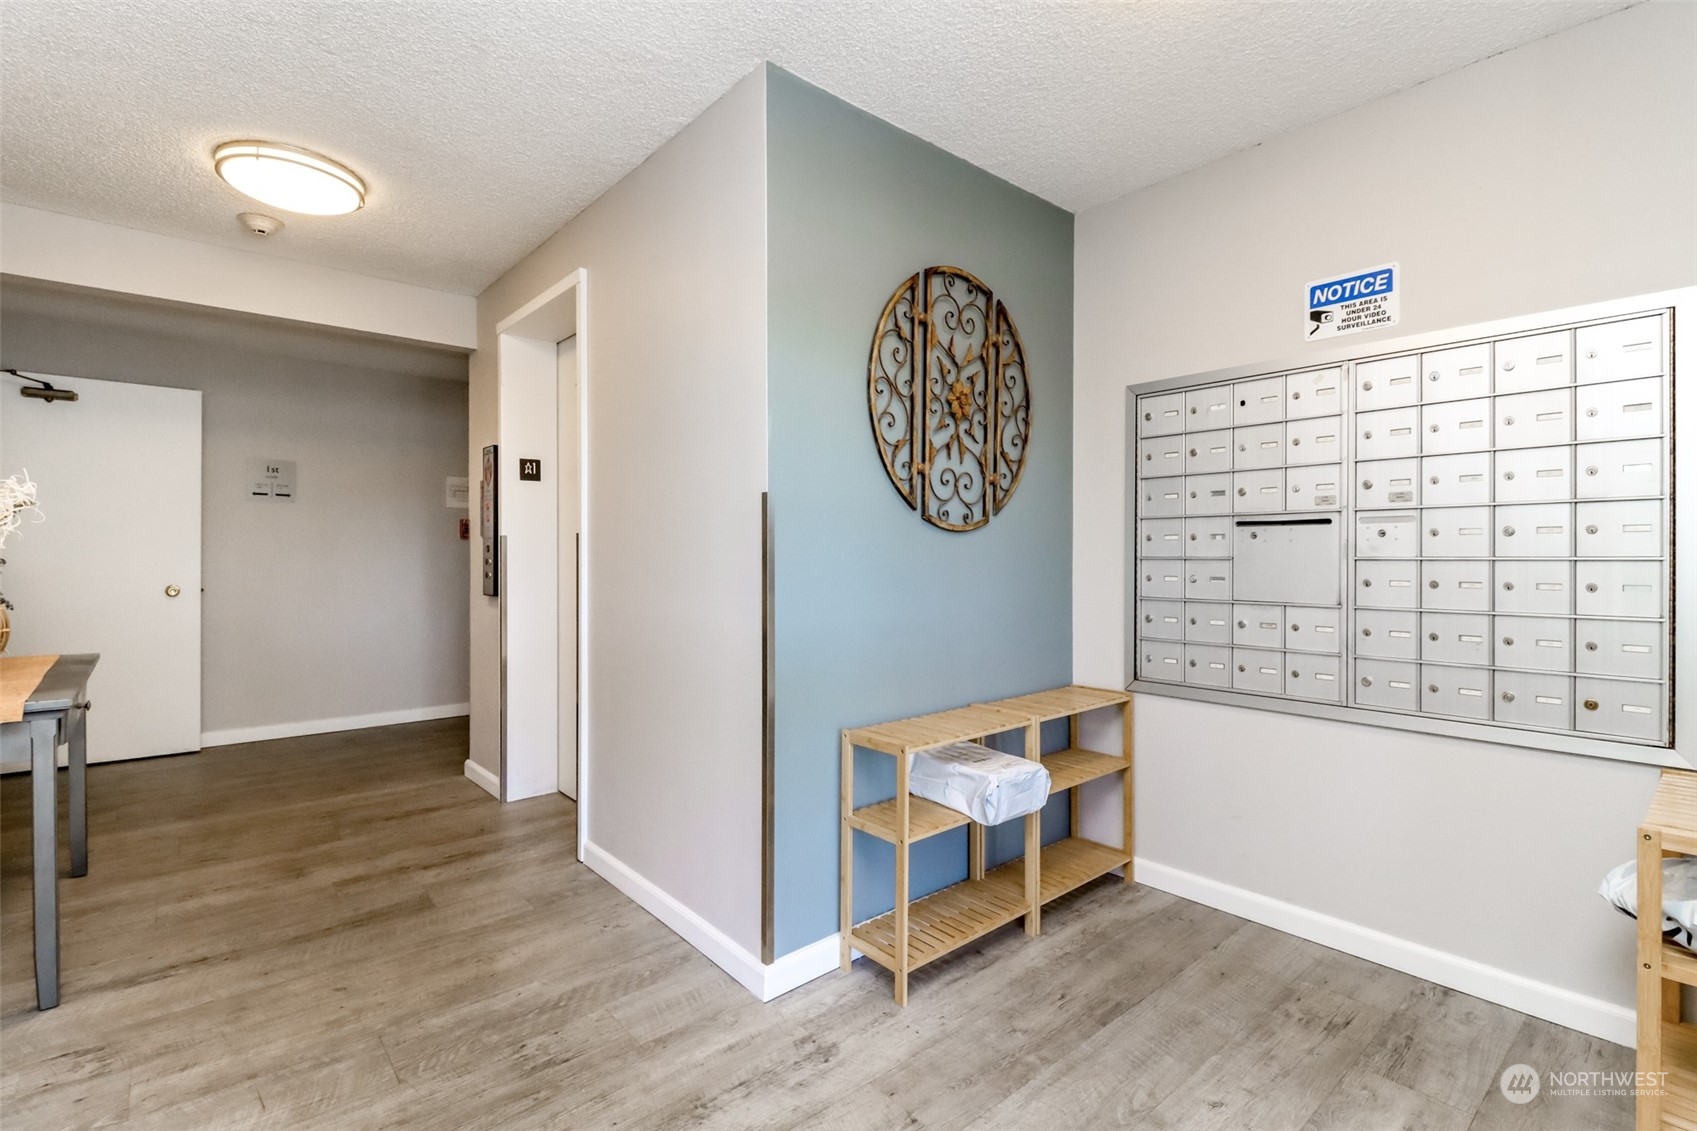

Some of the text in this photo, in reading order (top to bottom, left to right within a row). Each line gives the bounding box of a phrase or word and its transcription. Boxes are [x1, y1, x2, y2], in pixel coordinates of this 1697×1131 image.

[1313, 273, 1389, 304] NOTICE
[1340, 302, 1357, 310] THIS
[1359, 298, 1378, 306] AREA
[1341, 310, 1387, 323] HOUR VIDEO
[1346, 307, 1371, 316] UNDER
[1336, 315, 1391, 331] SURVEILLANCE
